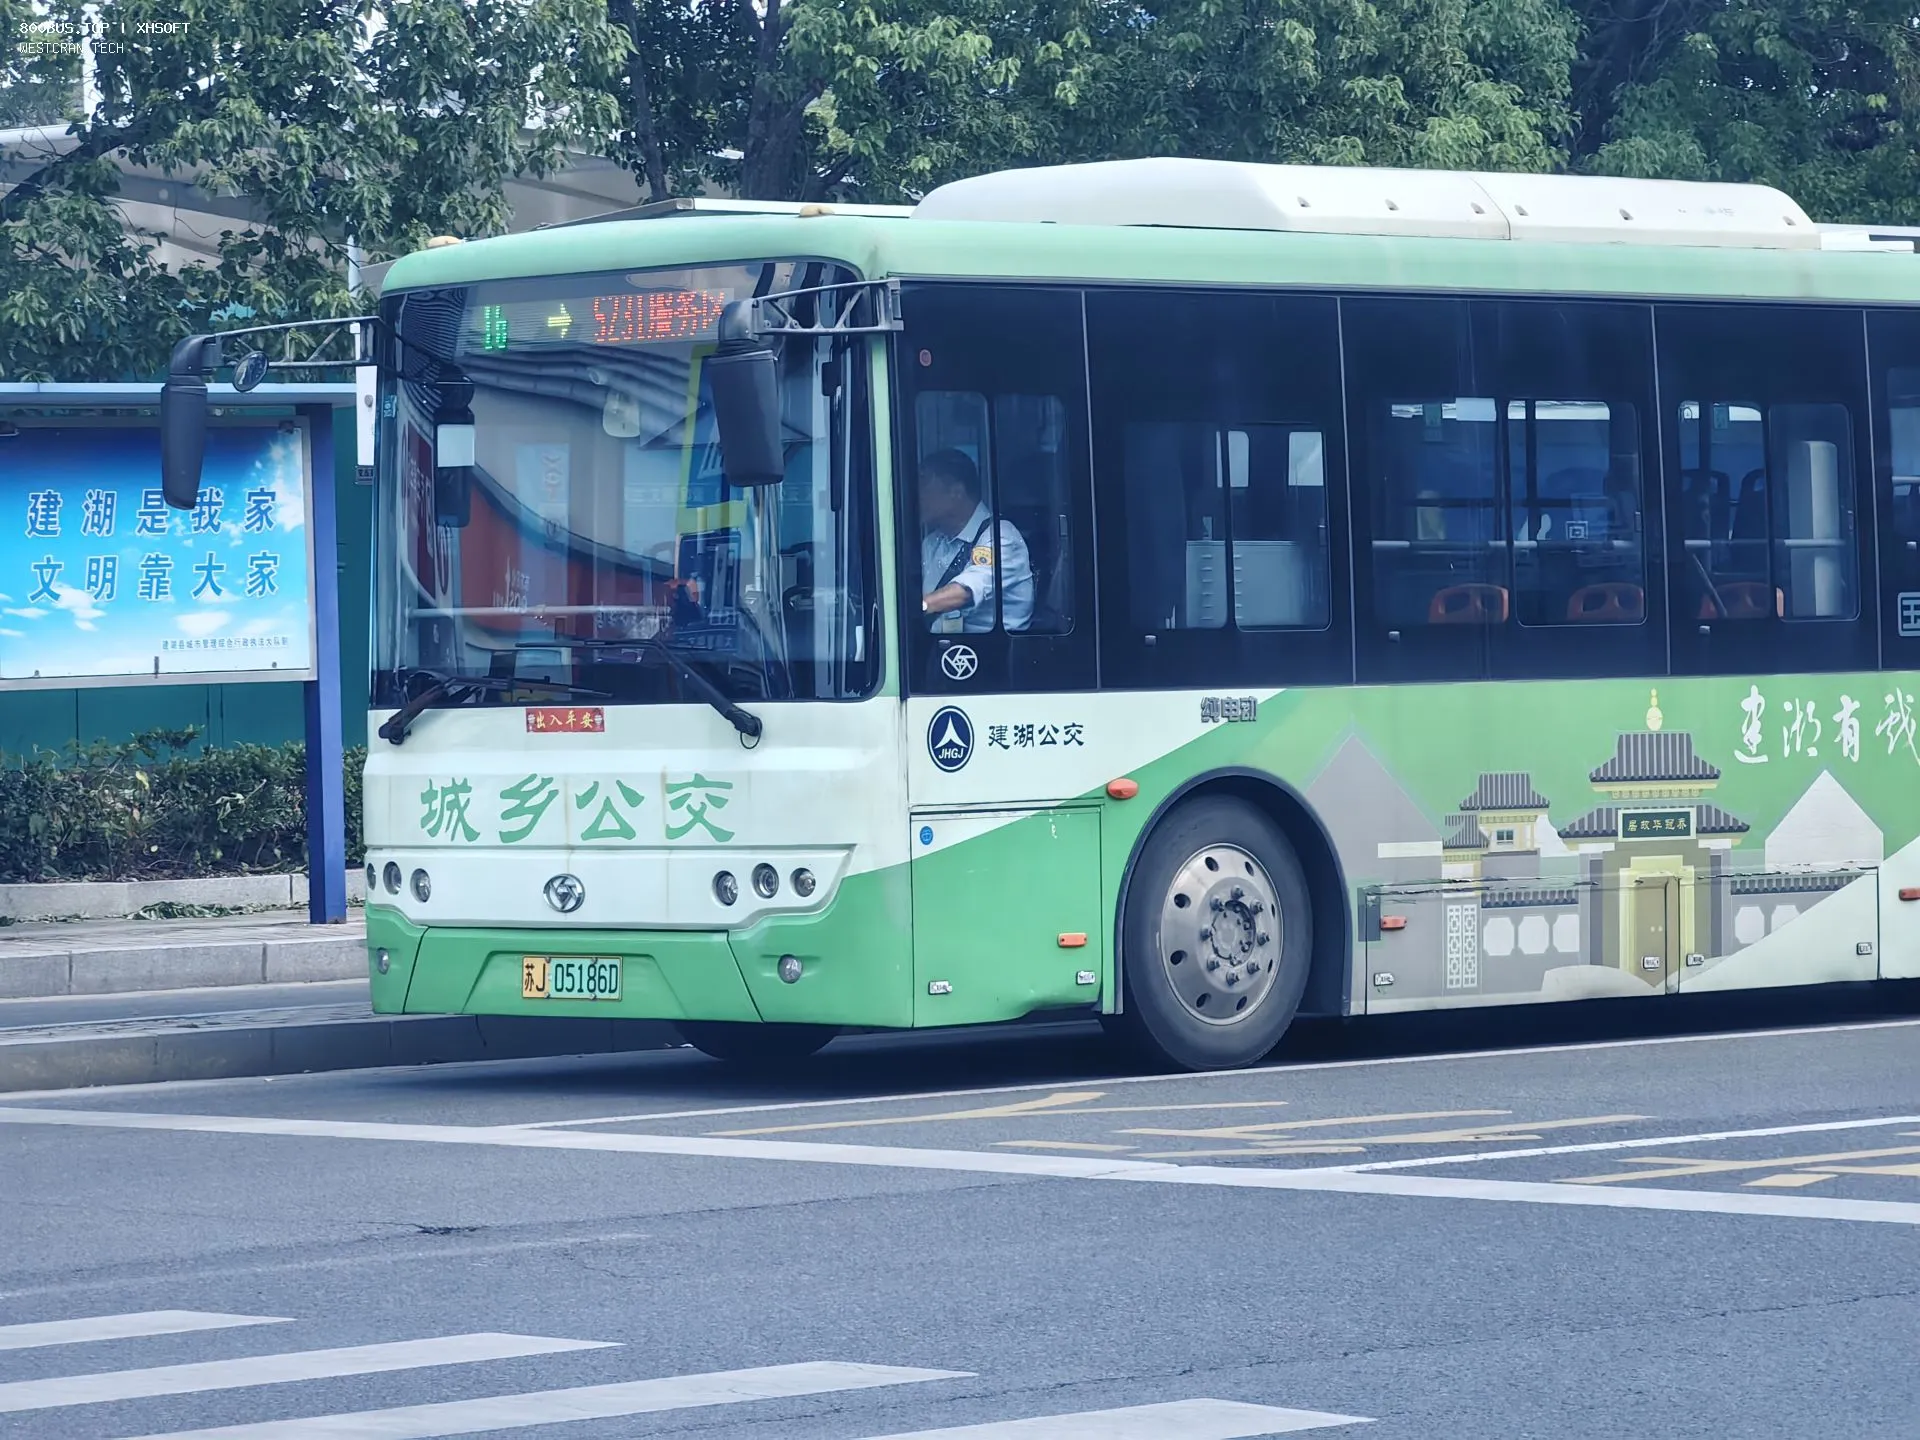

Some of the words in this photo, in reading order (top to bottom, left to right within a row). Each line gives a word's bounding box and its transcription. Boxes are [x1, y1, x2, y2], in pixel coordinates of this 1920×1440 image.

[26, 487, 277, 537] 建湖是我家
[29, 551, 280, 601] 文明靠大家
[535, 712, 593, 730] 出入平安
[1200, 696, 1257, 723] 纯电动
[988, 723, 1085, 749] 建湖公交
[938, 748, 964, 760] JHGJ
[420, 773, 735, 844] 城乡公交
